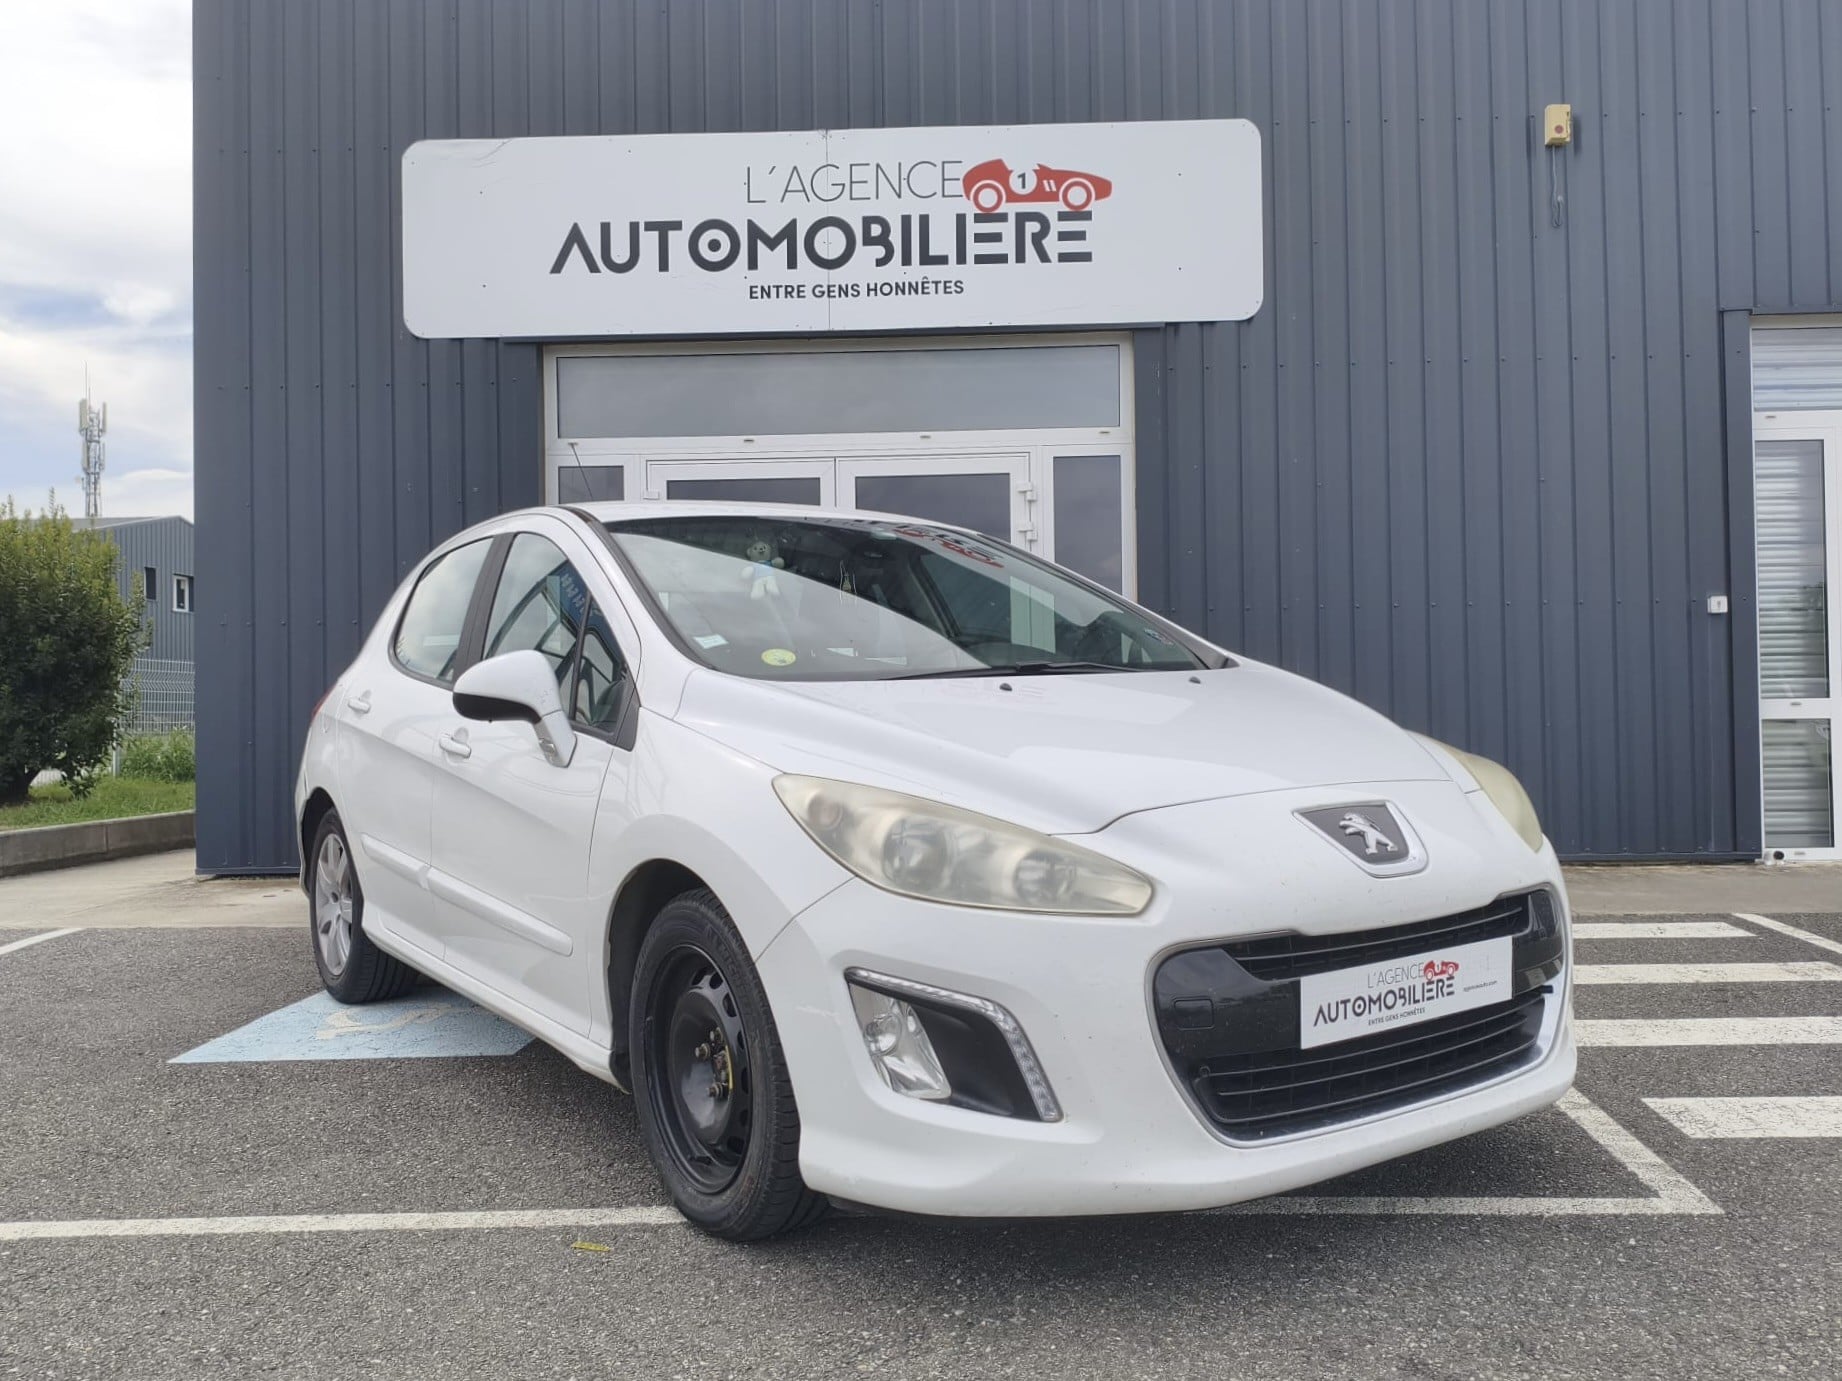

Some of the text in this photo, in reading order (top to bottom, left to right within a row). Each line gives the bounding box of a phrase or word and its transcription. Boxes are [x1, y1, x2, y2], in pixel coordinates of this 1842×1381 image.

[746, 160, 963, 203] L'AGENCE
[749, 275, 965, 300] ENTRE GENS HONNÊTES
[1367, 961, 1424, 989] L'AGENCE
[1368, 1015, 1384, 1026] ENTRE
[1384, 1012, 1399, 1022] GENS
